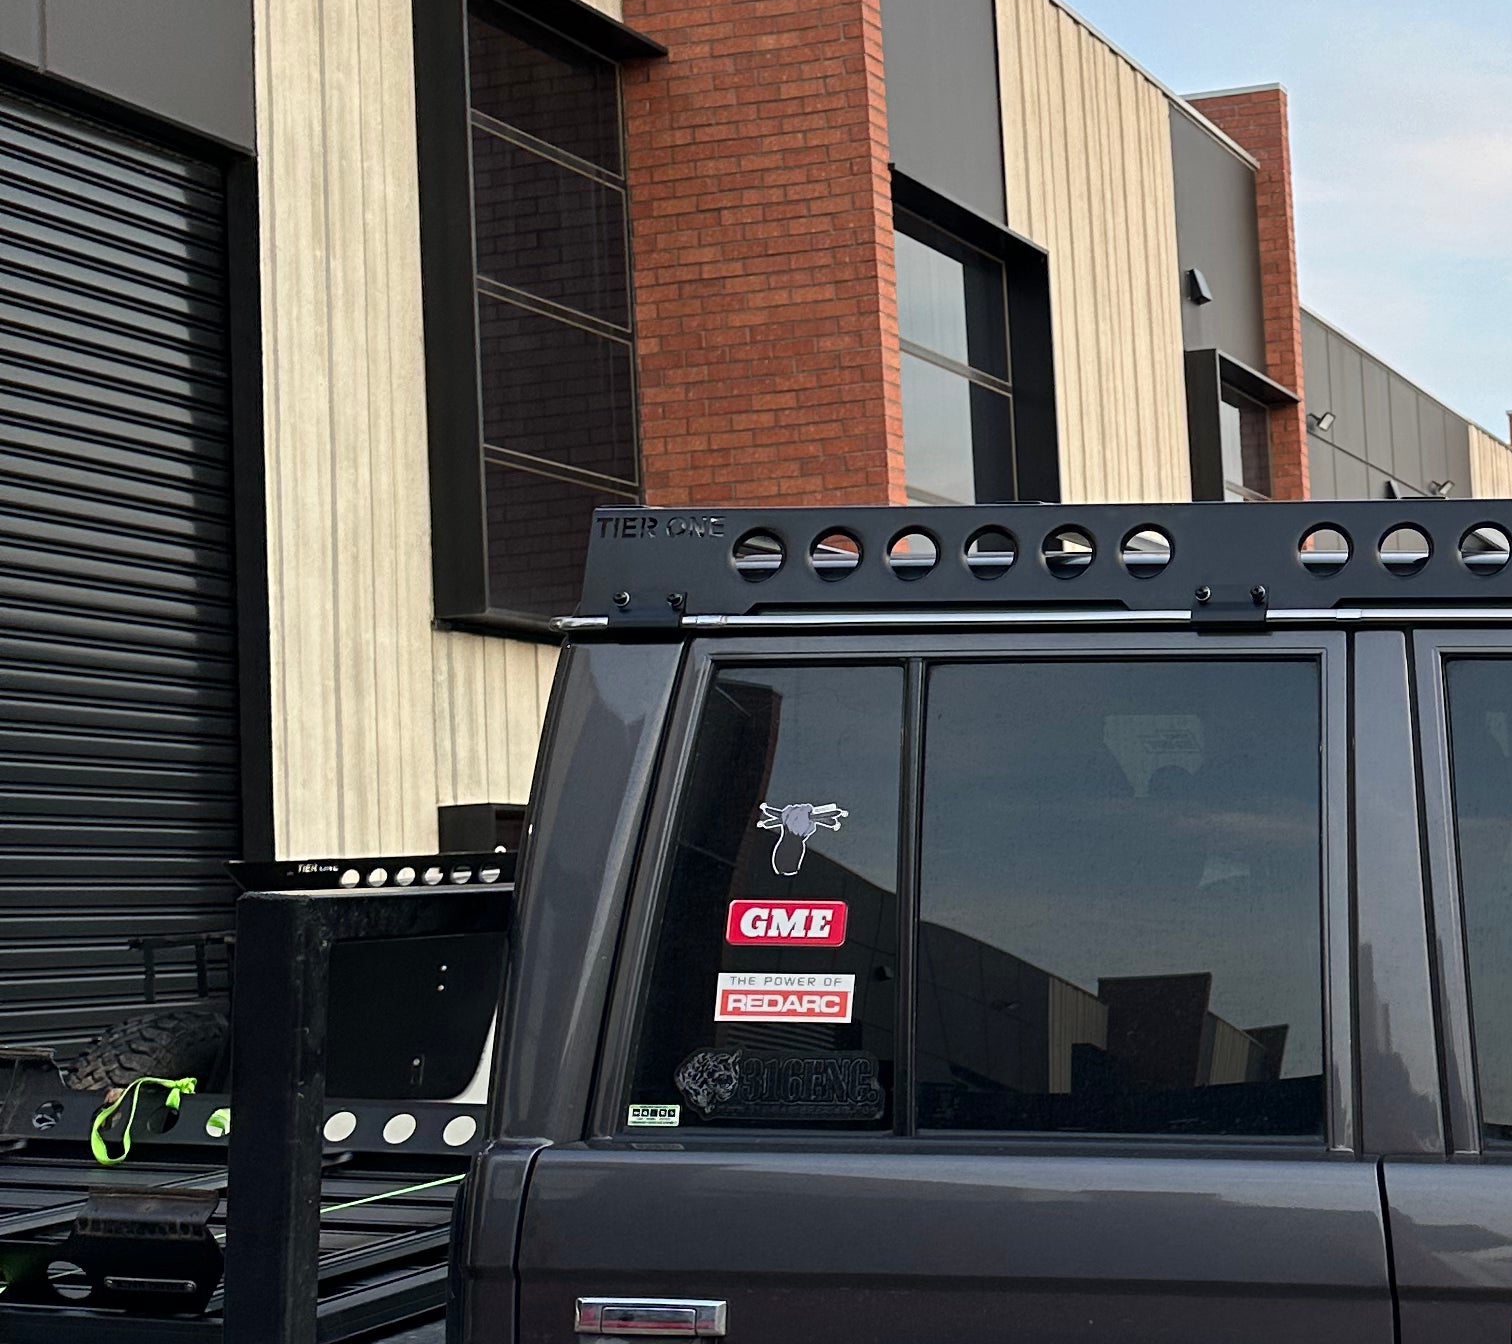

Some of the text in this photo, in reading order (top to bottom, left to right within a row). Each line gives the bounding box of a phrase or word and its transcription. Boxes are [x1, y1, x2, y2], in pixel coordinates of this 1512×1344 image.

[597, 516, 726, 538] TIER ONE
[740, 907, 834, 937] GME
[730, 976, 843, 987] THE POWER OF
[727, 993, 841, 1014] REDARC
